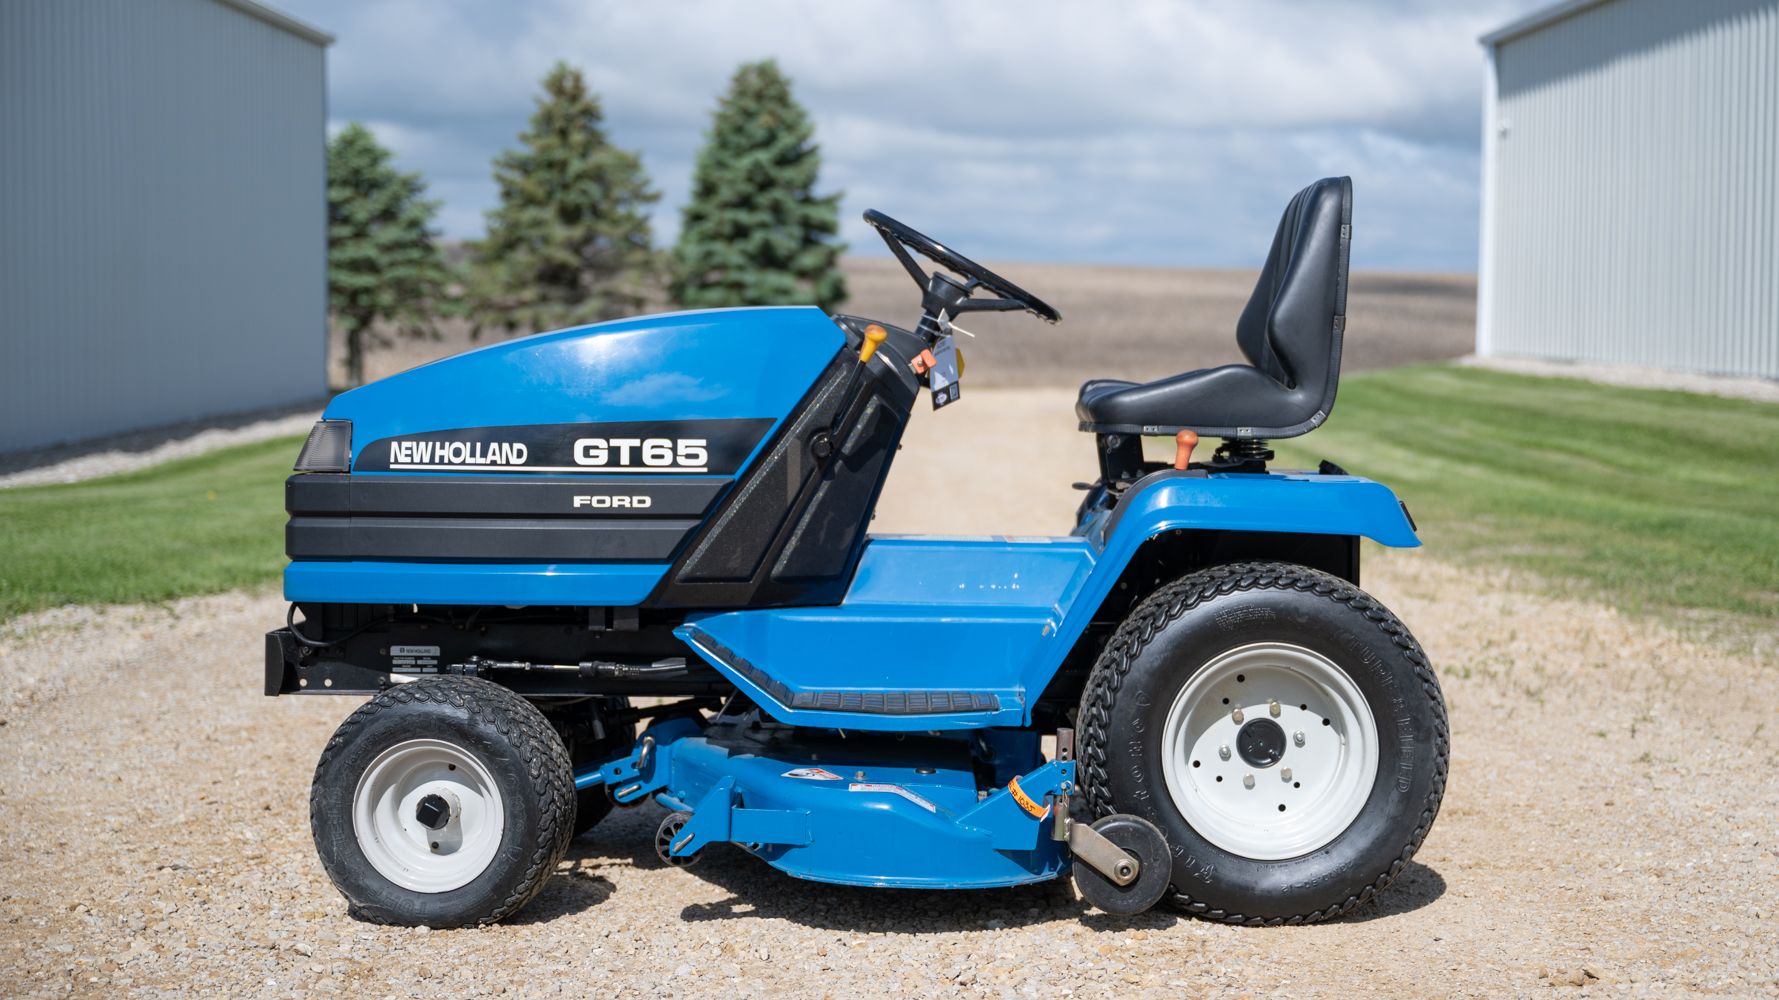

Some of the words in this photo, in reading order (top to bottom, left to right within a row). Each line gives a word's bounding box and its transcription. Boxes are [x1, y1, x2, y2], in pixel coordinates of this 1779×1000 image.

[389, 441, 433, 463] NEW
[434, 441, 528, 465] HOLLAND
[573, 438, 708, 467] GT65
[573, 496, 652, 508] FORD
